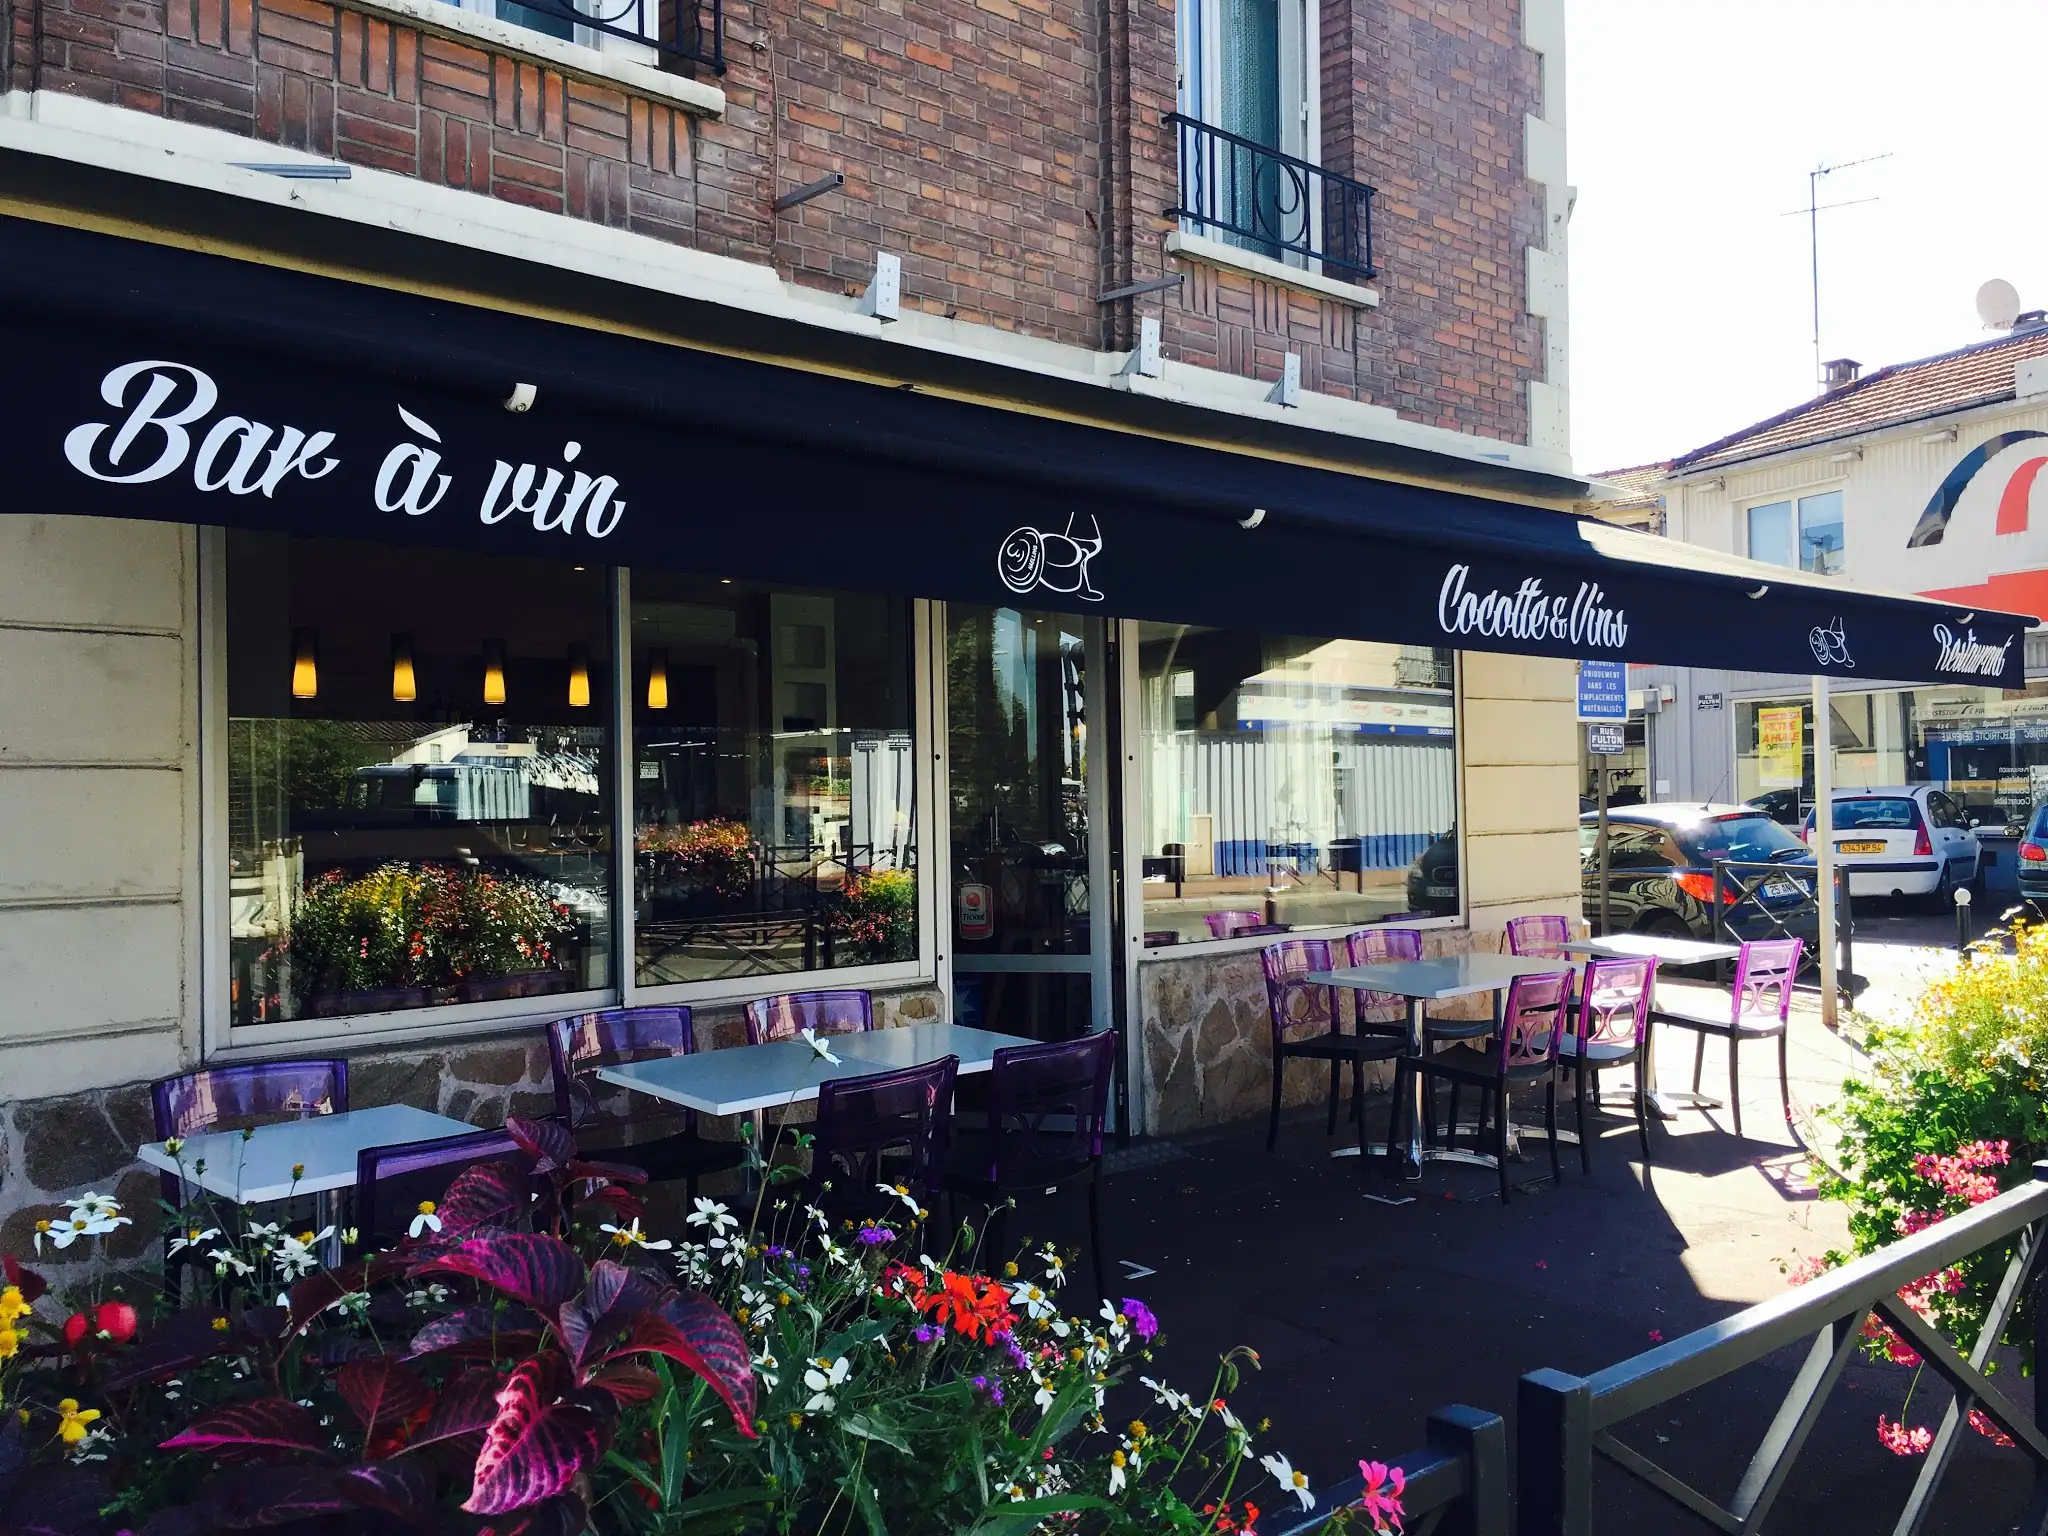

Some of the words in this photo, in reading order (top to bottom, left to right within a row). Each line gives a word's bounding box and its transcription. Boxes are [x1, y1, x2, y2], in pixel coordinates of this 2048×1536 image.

[64, 360, 340, 498] Bar
[373, 403, 453, 515] à
[479, 441, 627, 538] vin
[1932, 623, 2015, 677] Restaurant
[1583, 670, 1620, 679] UNIQUEMENT
[1587, 682, 1602, 690] DANS
[1580, 693, 1625, 702] EMPLACEMENTS
[1599, 727, 1615, 736] RUE
[1591, 735, 1623, 745] FULTON
[1842, 844, 1860, 852] 5343
[1769, 884, 1781, 896] 25
[962, 913, 985, 921] Ticket
